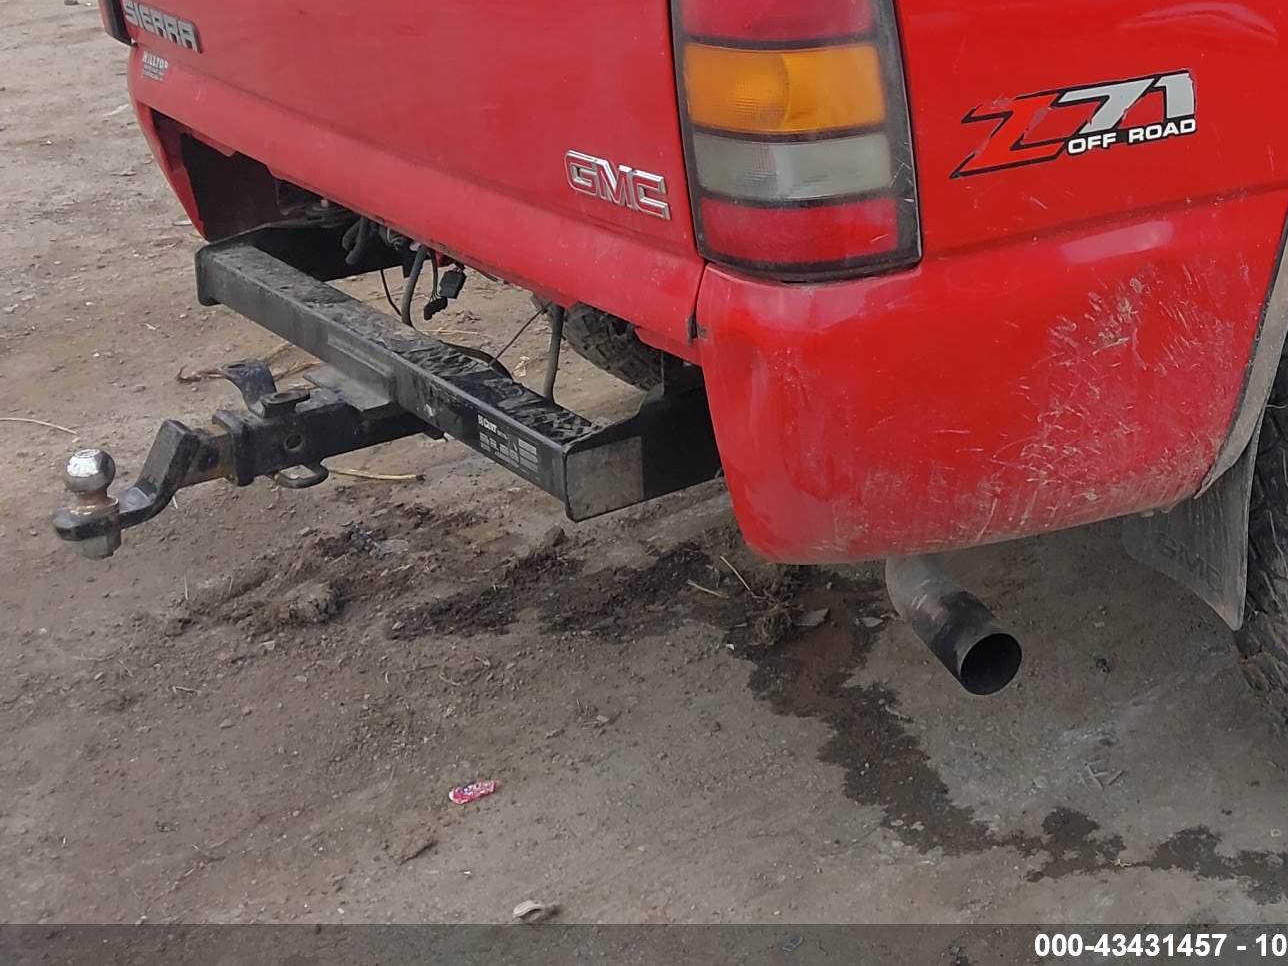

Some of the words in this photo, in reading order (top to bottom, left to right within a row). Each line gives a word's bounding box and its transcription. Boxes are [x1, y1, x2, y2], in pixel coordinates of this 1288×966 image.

[949, 70, 1196, 179] Z71
[1067, 132, 1117, 155] OFF
[1128, 118, 1196, 143] ROAD
[564, 149, 672, 220] GMC
